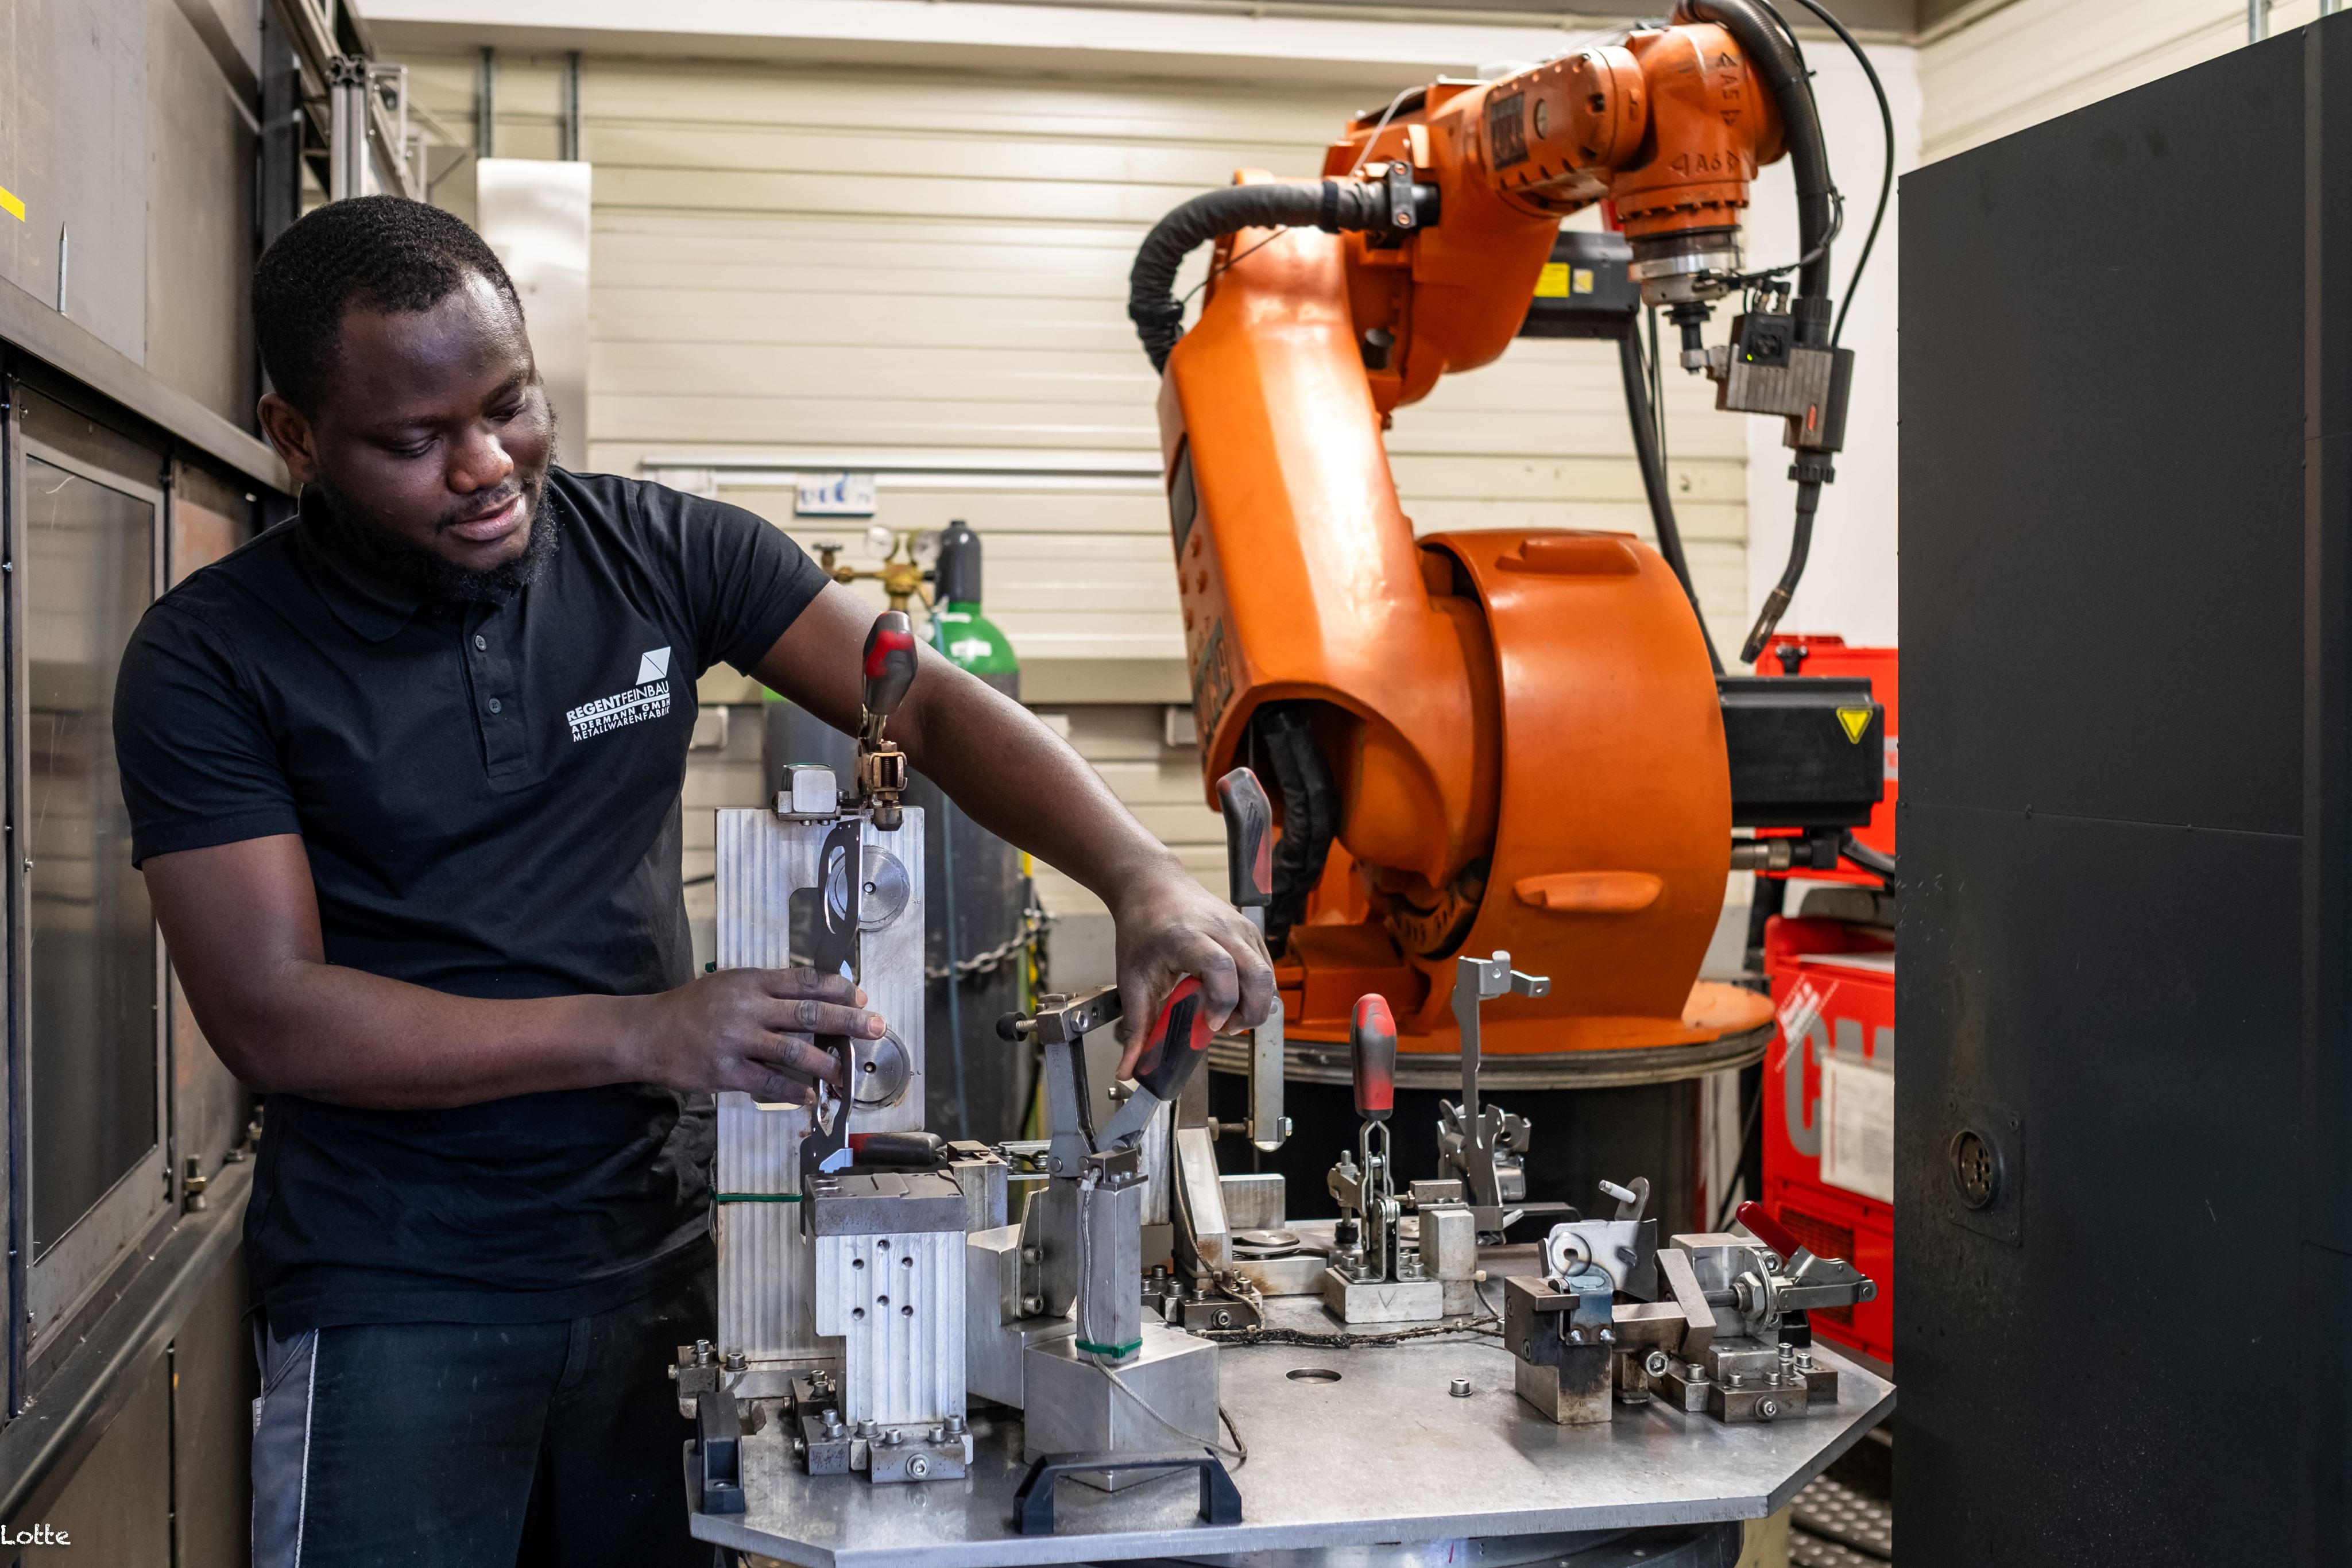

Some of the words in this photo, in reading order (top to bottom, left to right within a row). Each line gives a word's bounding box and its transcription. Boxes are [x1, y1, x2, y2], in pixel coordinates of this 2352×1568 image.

[566, 680, 670, 722] REGENTFEINBAU
[572, 707, 636, 734] ADERMANN
[641, 698, 671, 712] GMBH
[573, 706, 671, 742] METALLWARENFABRIK
